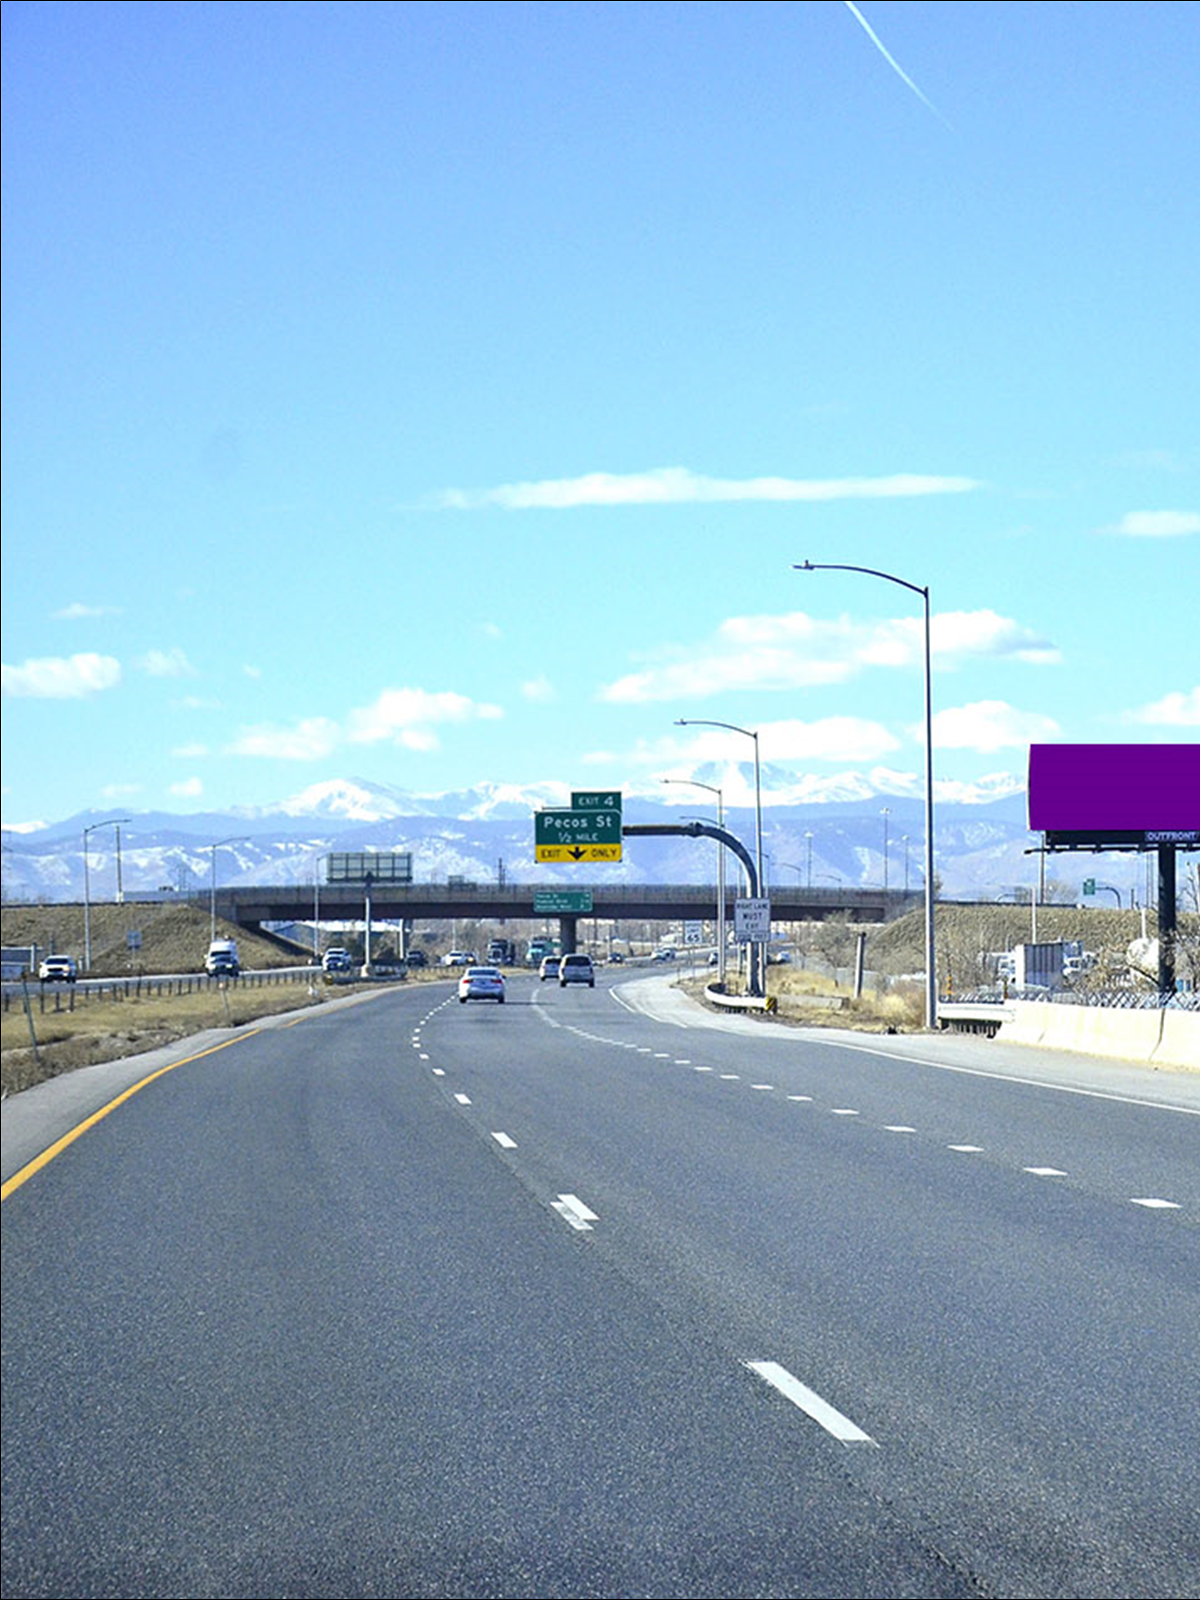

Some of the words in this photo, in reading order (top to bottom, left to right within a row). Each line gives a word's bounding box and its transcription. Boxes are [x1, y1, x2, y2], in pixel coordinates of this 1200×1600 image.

[578, 796, 599, 807] EXIT
[603, 795, 614, 807] 4
[543, 815, 588, 829] Pecos
[595, 814, 613, 828] St
[575, 832, 599, 842] MILE
[1146, 831, 1198, 841] OUTFRONT
[540, 848, 562, 859] EXIT
[590, 847, 617, 859] ONLY
[742, 911, 763, 920] MUST
[687, 933, 700, 942] 65
